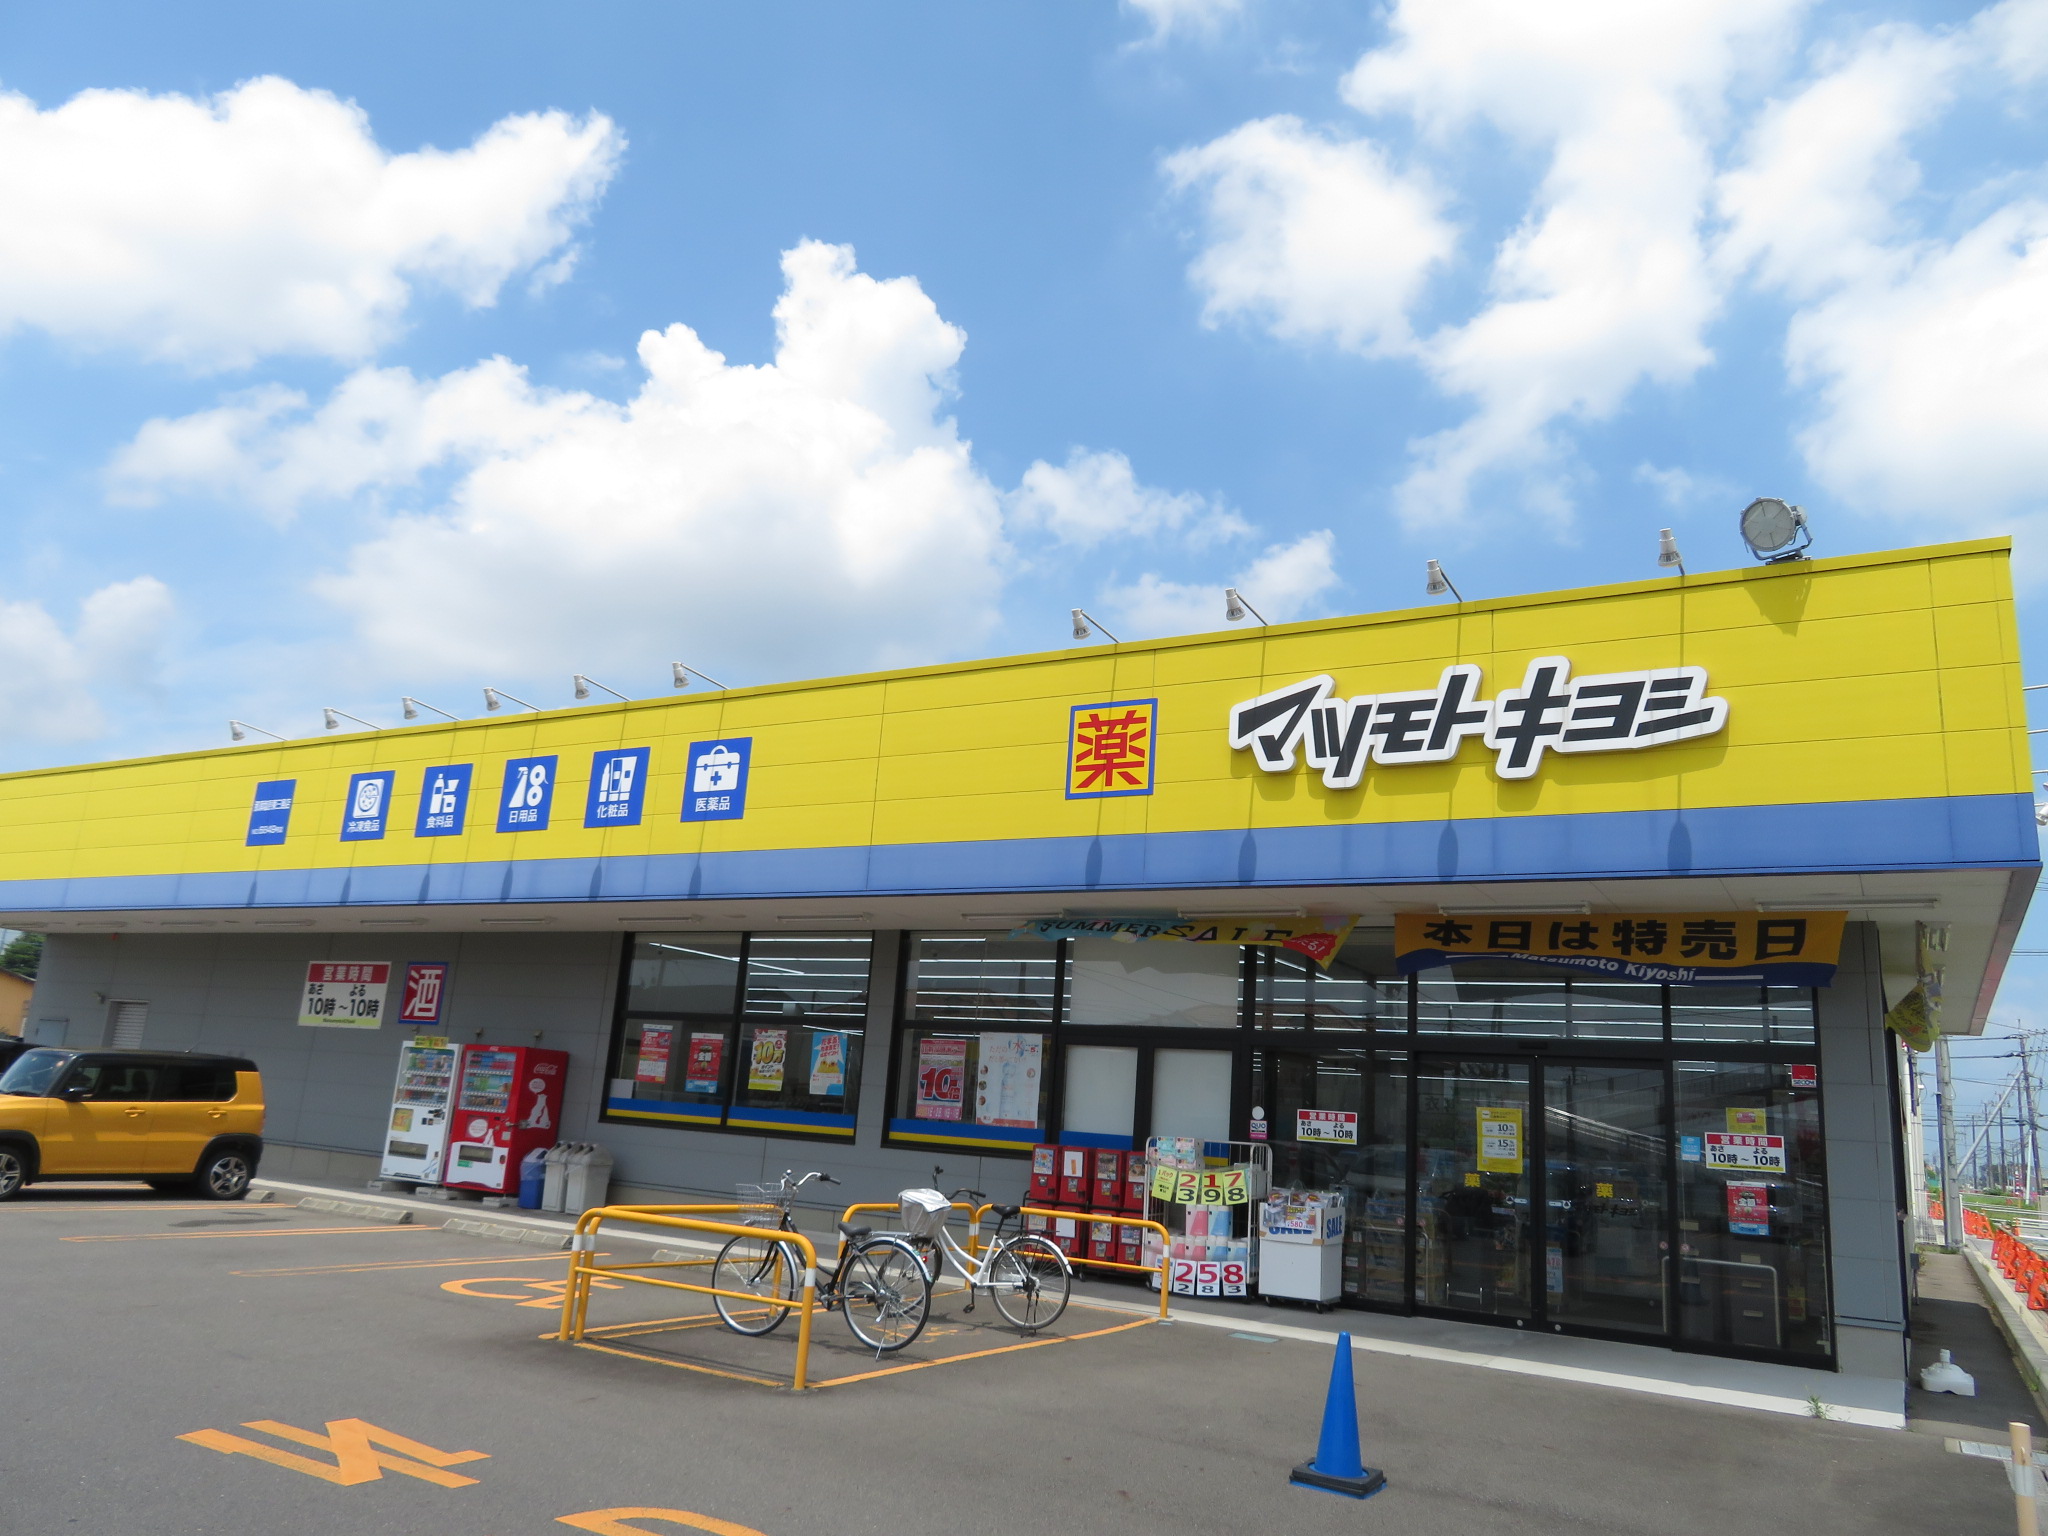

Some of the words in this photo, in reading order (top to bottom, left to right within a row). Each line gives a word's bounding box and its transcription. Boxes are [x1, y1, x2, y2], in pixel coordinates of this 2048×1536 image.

[1236, 663, 1716, 781] マツモトキヨシ
[1074, 708, 1148, 789] 薬
[596, 803, 629, 819] 化粧品
[694, 795, 731, 812] 医薬品
[425, 814, 454, 829] 食料品
[508, 808, 538, 824] 日用品
[346, 819, 381, 833] 冷凍食品
[1040, 918, 1162, 939] SUMMER
[1422, 918, 1808, 961] 本日は特売日
[322, 965, 374, 982] 営業時間
[1624, 962, 1697, 982] Kiyoshi
[307, 983, 325, 995] あさ
[349, 984, 367, 997] よる
[404, 968, 443, 1018] 酒
[1309, 1112, 1346, 1122] 営業時間
[1720, 1135, 1769, 1146] 営業時間
[1710, 1145, 1725, 1153] あさ
[1753, 1147, 1768, 1155] よる
[1290, 1220, 1304, 1228] 580
[1326, 1214, 1343, 1239] SALE
[1175, 1262, 1244, 1284] 258
